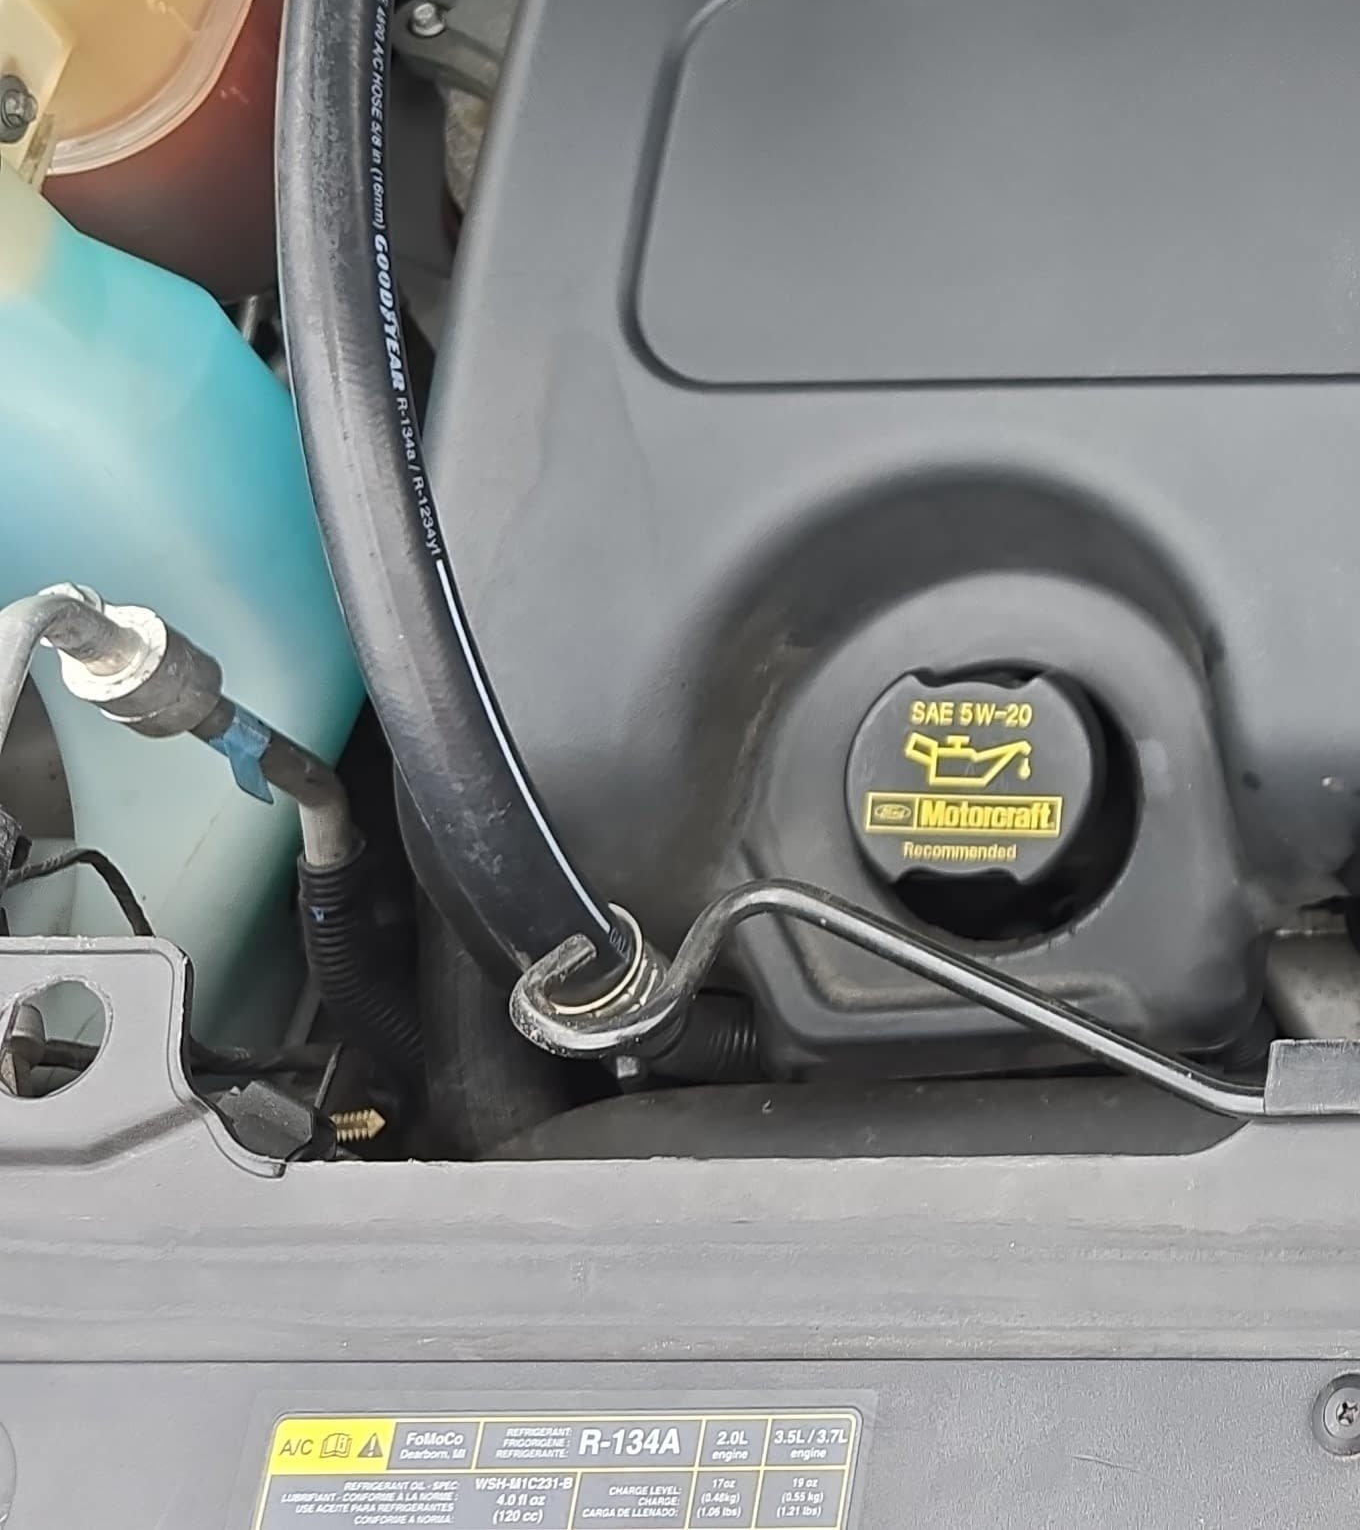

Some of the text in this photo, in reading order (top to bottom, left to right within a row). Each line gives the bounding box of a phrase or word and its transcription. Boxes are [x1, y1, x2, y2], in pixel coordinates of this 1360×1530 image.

[372, 39, 386, 72] A/C
[371, 74, 384, 116] HOSE
[371, 120, 386, 146] 5/8
[369, 167, 386, 230] (16mm)
[374, 234, 406, 391] GOODYEAR
[396, 396, 416, 462] R-134a
[911, 701, 1033, 727] SAE 5W-20
[921, 800, 1051, 829] Motorcraft
[903, 841, 1017, 861] Recommended
[406, 1432, 464, 1446] FoMoCo
[578, 1428, 680, 1455] R-134A
[716, 1431, 749, 1446] 2.0L
[774, 1430, 806, 1444] 3.5L
[816, 1429, 848, 1444] 3.7L
[279, 1439, 314, 1456] A/C
[790, 1448, 827, 1460] engine
[712, 1449, 749, 1462] engine
[343, 1480, 409, 1491] REFRIGERANT
[475, 1477, 574, 1491] WSH-M1C231-B
[609, 1485, 683, 1496] CHARGE LEVEL:
[792, 1478, 804, 1488] 19
[496, 1494, 546, 1506] 4.0 fl oz
[807, 1492, 824, 1504] kg)
[492, 1509, 544, 1525] (120 cc)
[582, 1509, 616, 1518] CARGA
[617, 1509, 630, 1518] DE
[776, 1507, 801, 1518] (1.21
